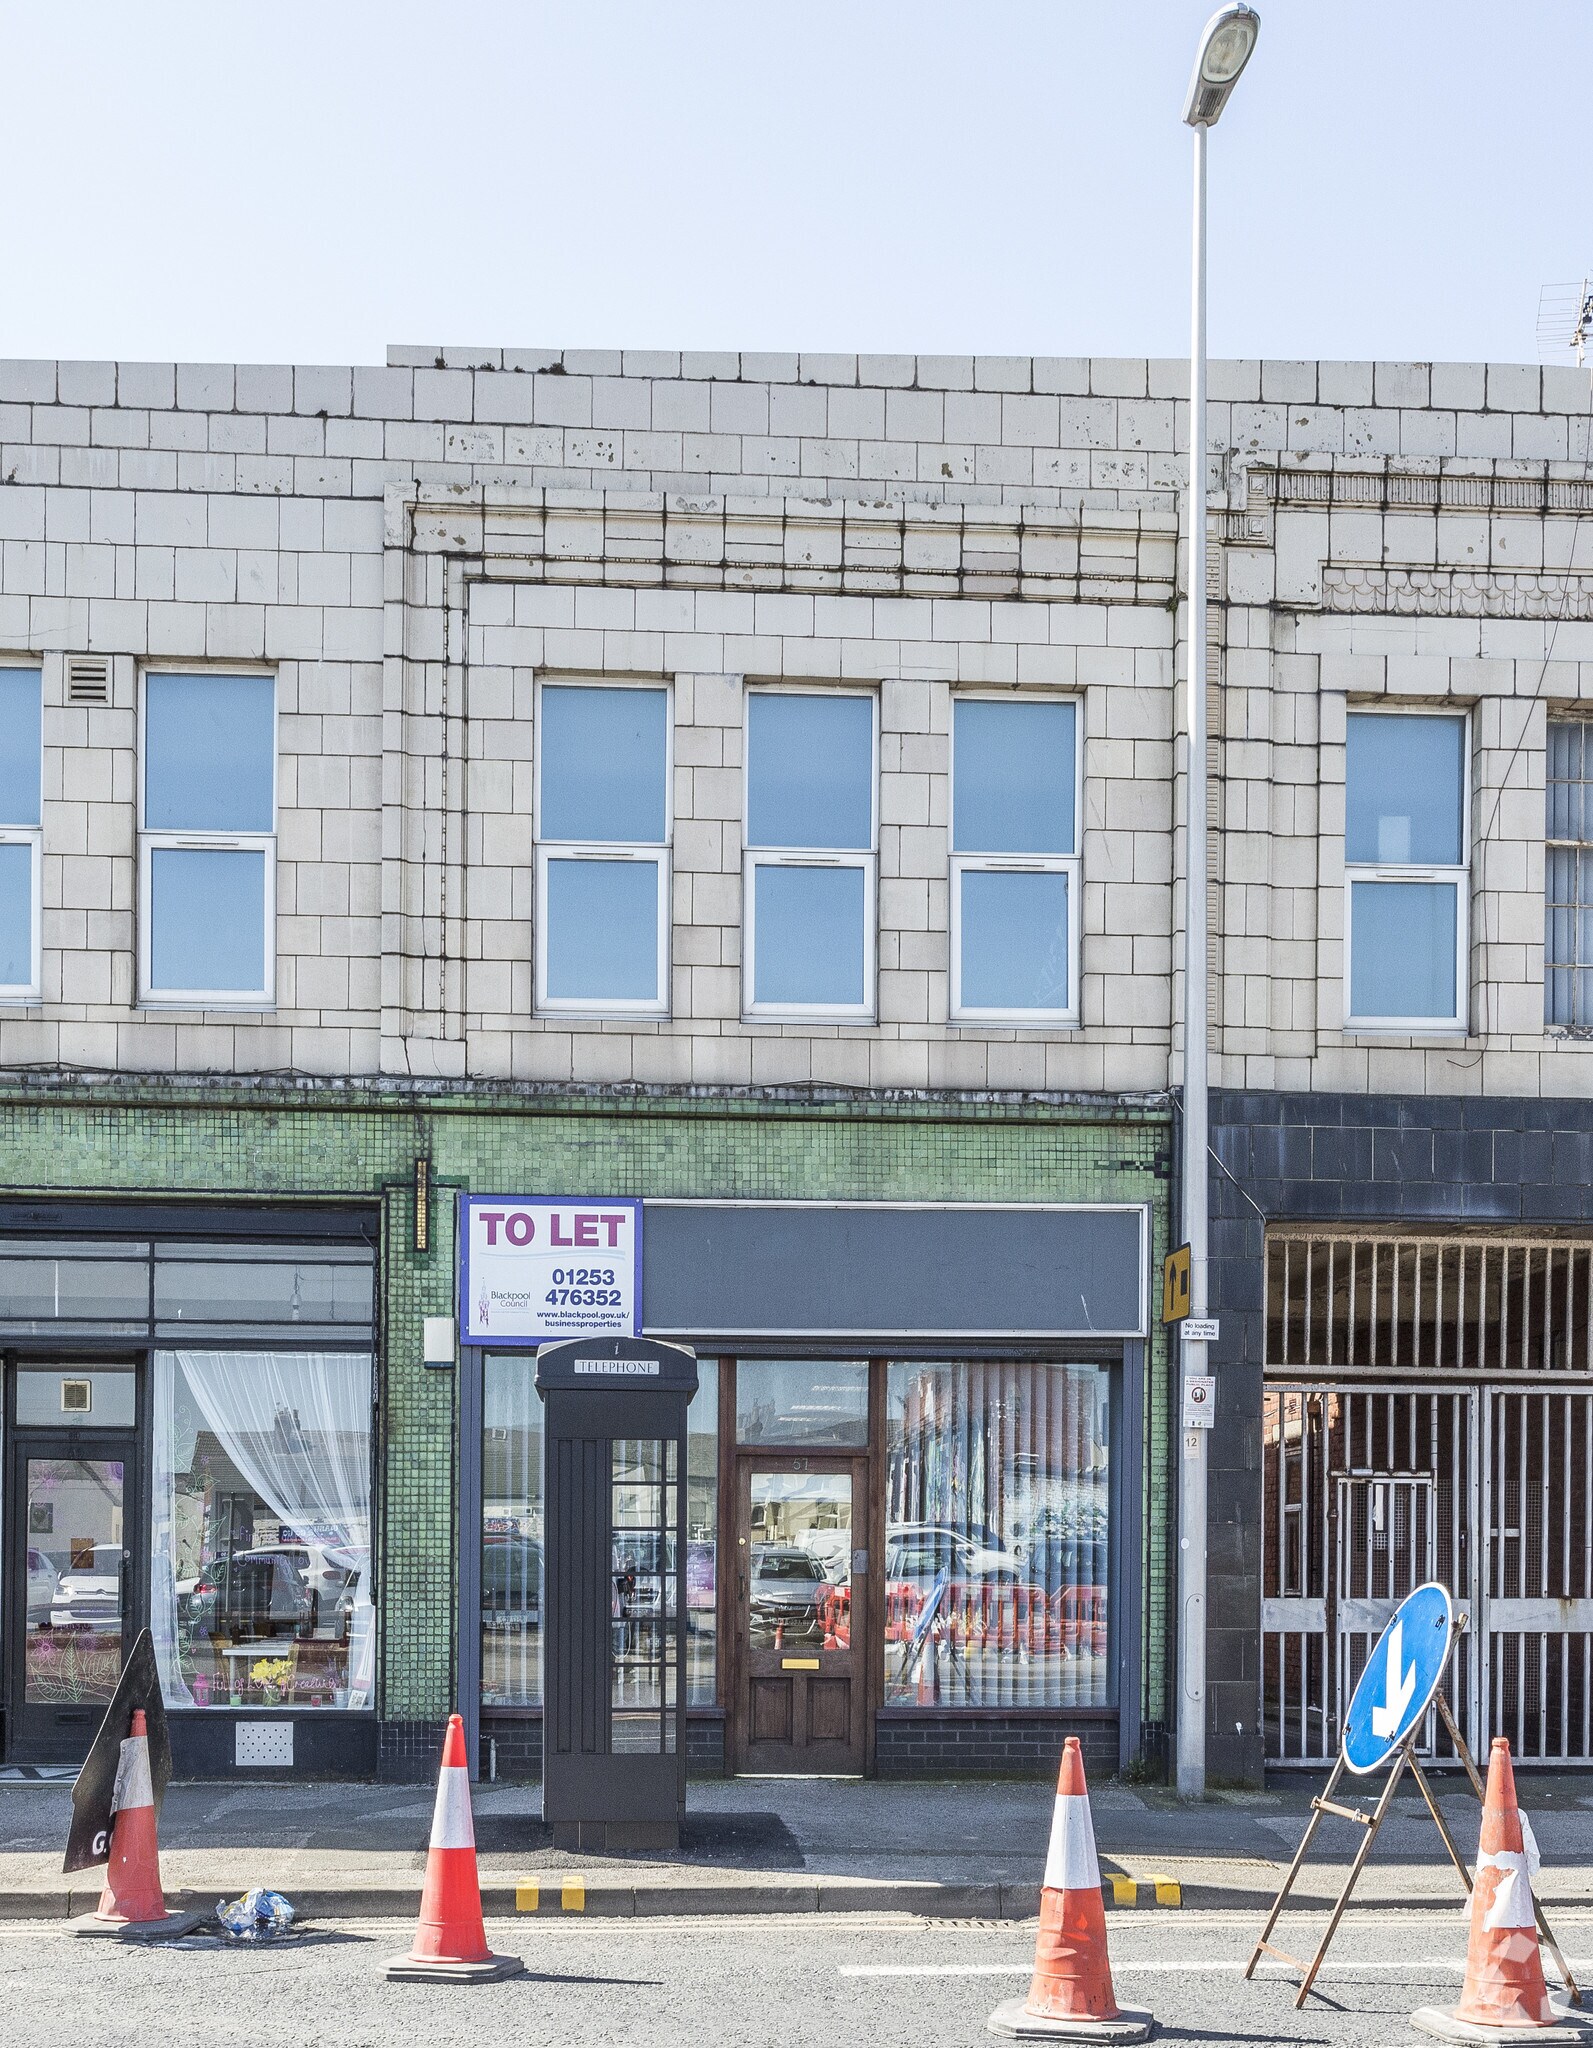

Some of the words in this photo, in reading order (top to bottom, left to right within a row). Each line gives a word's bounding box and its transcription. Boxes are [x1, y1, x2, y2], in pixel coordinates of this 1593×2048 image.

[479, 1212, 535, 1246] TO
[550, 1213, 626, 1247] LET
[552, 1268, 615, 1286] 01253
[490, 1290, 531, 1301] Blackpool
[545, 1289, 622, 1306] 476352
[500, 1300, 528, 1308] Council
[536, 1310, 630, 1320] www.blackpool.gov.uk/
[544, 1319, 622, 1328] businessproperties
[1194, 1322, 1215, 1331] loading
[579, 1361, 654, 1374] TELEPHONE
[1185, 1437, 1197, 1447] 12
